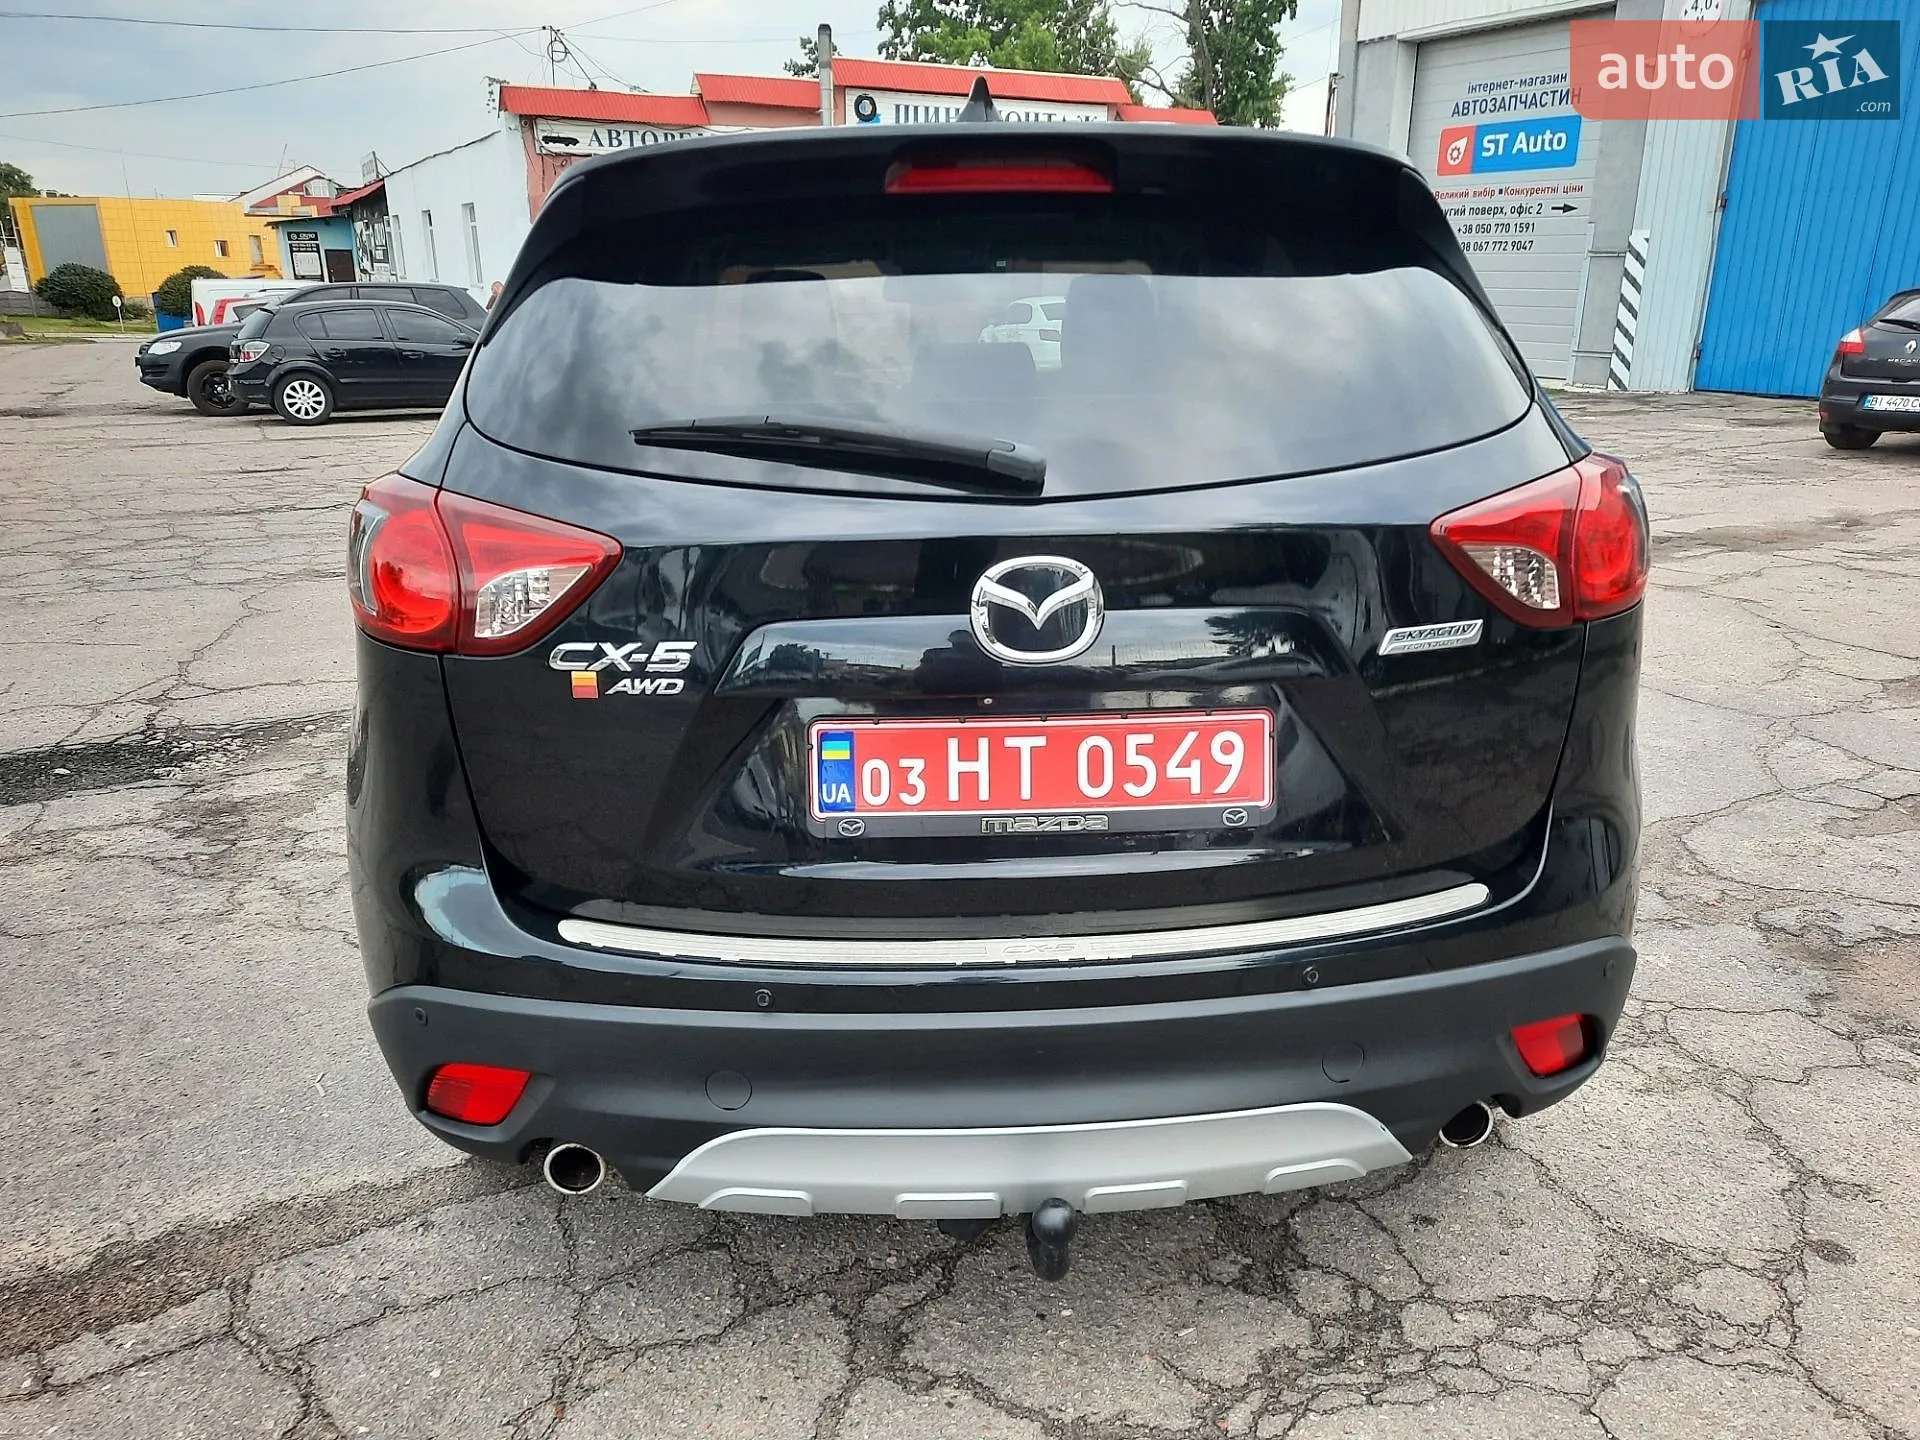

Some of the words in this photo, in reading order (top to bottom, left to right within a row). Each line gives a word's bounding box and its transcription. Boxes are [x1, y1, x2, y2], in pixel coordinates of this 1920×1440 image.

[1467, 72, 1568, 95] інтернет-магазин
[1451, 87, 1582, 118] АВТОЗАПЧАСТИН
[1481, 132, 1510, 158] ST
[1512, 129, 1567, 154] Auto
[1434, 189, 1470, 200] Великий
[1472, 187, 1496, 199] вибір
[1503, 183, 1559, 197] Конкурентні
[1562, 183, 1584, 194] ціни
[1468, 206, 1507, 218] поверх,
[1509, 203, 1534, 217] офіс
[1535, 203, 1543, 215] 2
[1457, 223, 1473, 235] +38
[1474, 223, 1492, 234] 050
[1494, 223, 1511, 234] 770
[1513, 222, 1536, 233] 1591
[1472, 241, 1489, 252] 067
[1491, 240, 1508, 251] 772
[1511, 240, 1534, 251] 9047
[1886, 398, 1910, 408] 4470
[1395, 623, 1479, 641] SKYACTIV
[548, 641, 698, 673] CX-5
[604, 677, 685, 696] AWD
[861, 757, 927, 807] 03
[946, 734, 1048, 802] HT
[1075, 729, 1246, 799] 0549
[822, 782, 851, 804] UA
[1002, 942, 1078, 955] CX-5
